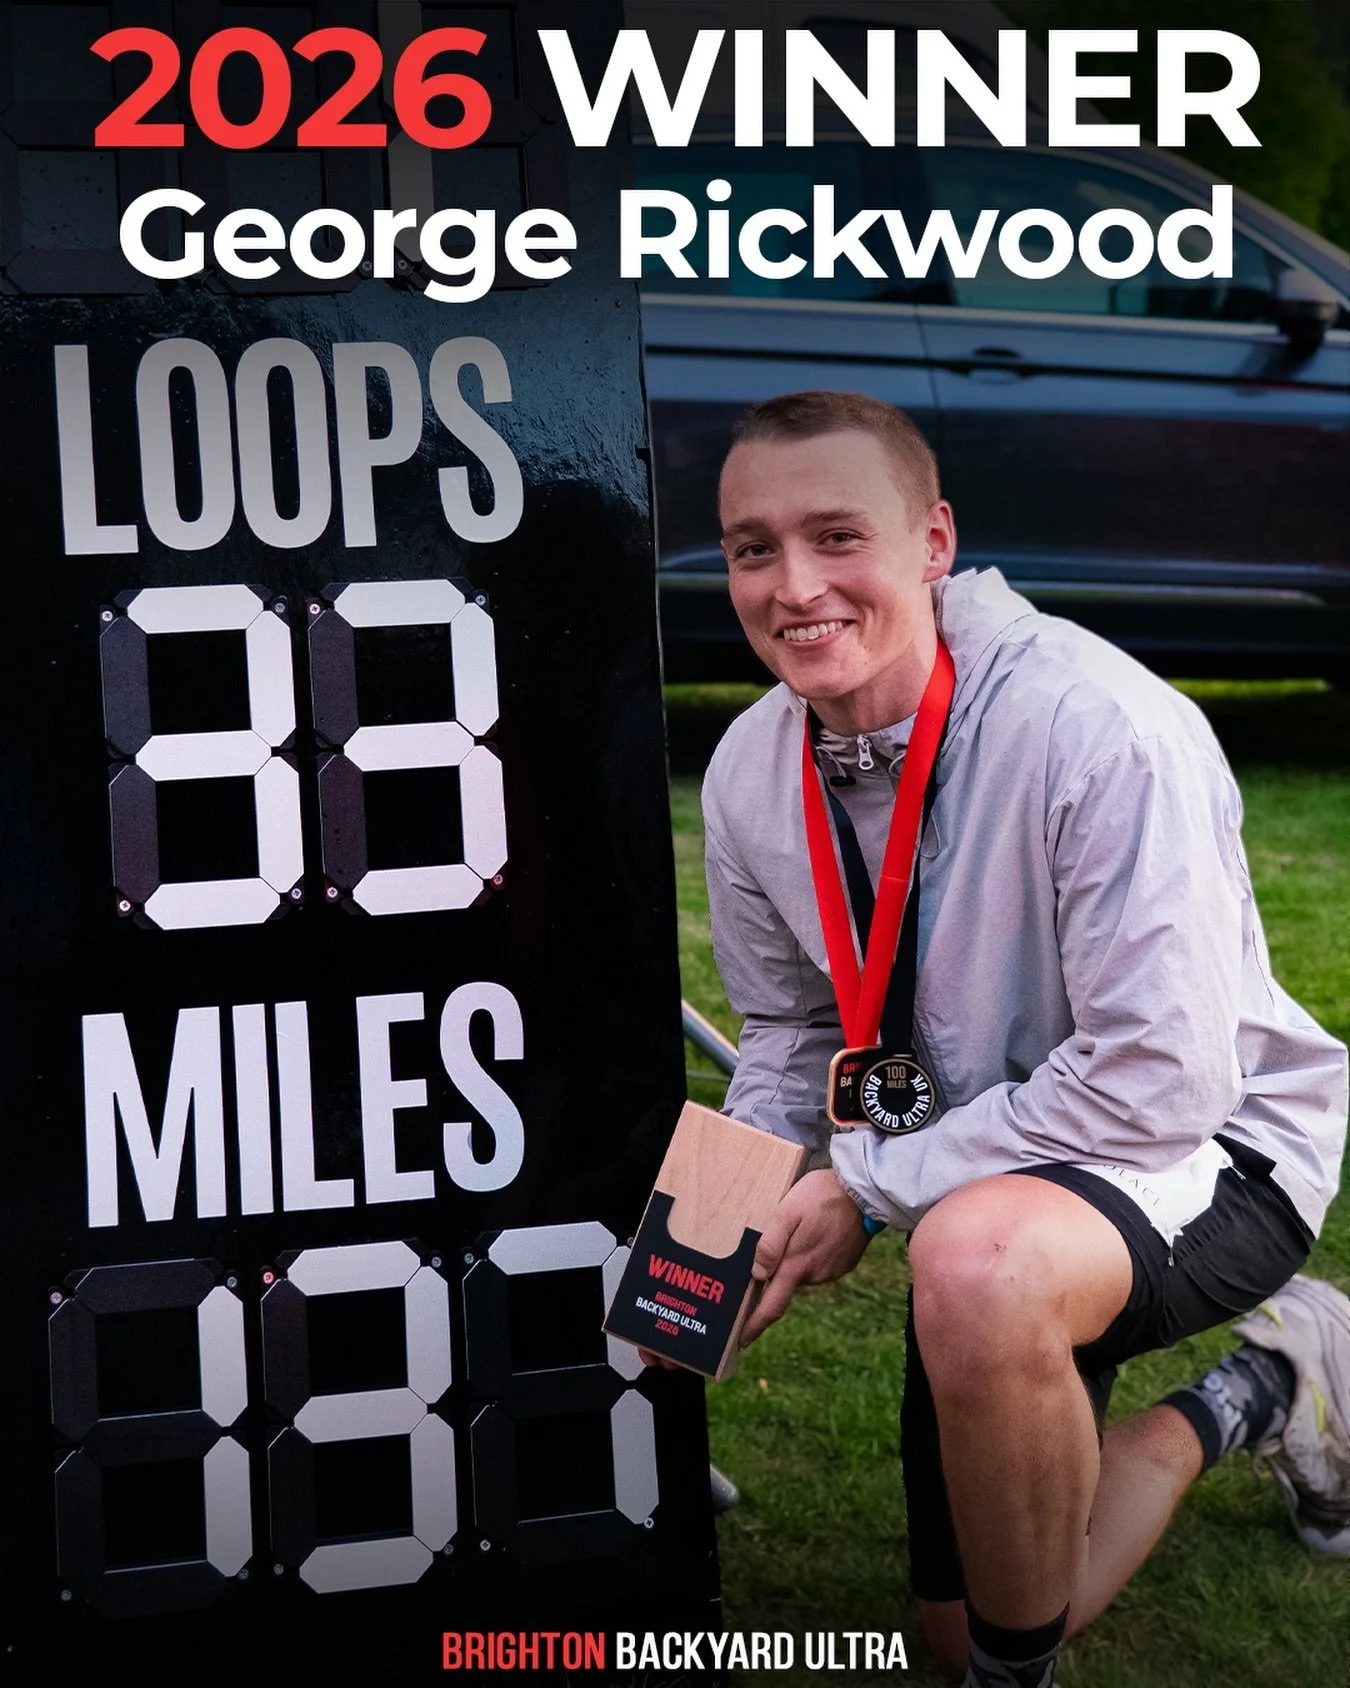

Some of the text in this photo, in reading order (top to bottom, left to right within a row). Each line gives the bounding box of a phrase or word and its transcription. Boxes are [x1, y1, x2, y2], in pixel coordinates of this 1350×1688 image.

[54, 336, 525, 556] LOOPS
[126, 579, 508, 930] 33
[885, 1065, 906, 1079] 100
[887, 1080, 907, 1089] MILES
[82, 981, 525, 1228] MILES
[864, 1073, 931, 1128] BACKYARD ULTRA UK
[649, 1254, 725, 1303] WINNER
[635, 1296, 706, 1335] BACKYARD ULTRA
[655, 1291, 697, 1316] BRIGHTON
[655, 1319, 679, 1336] 2026
